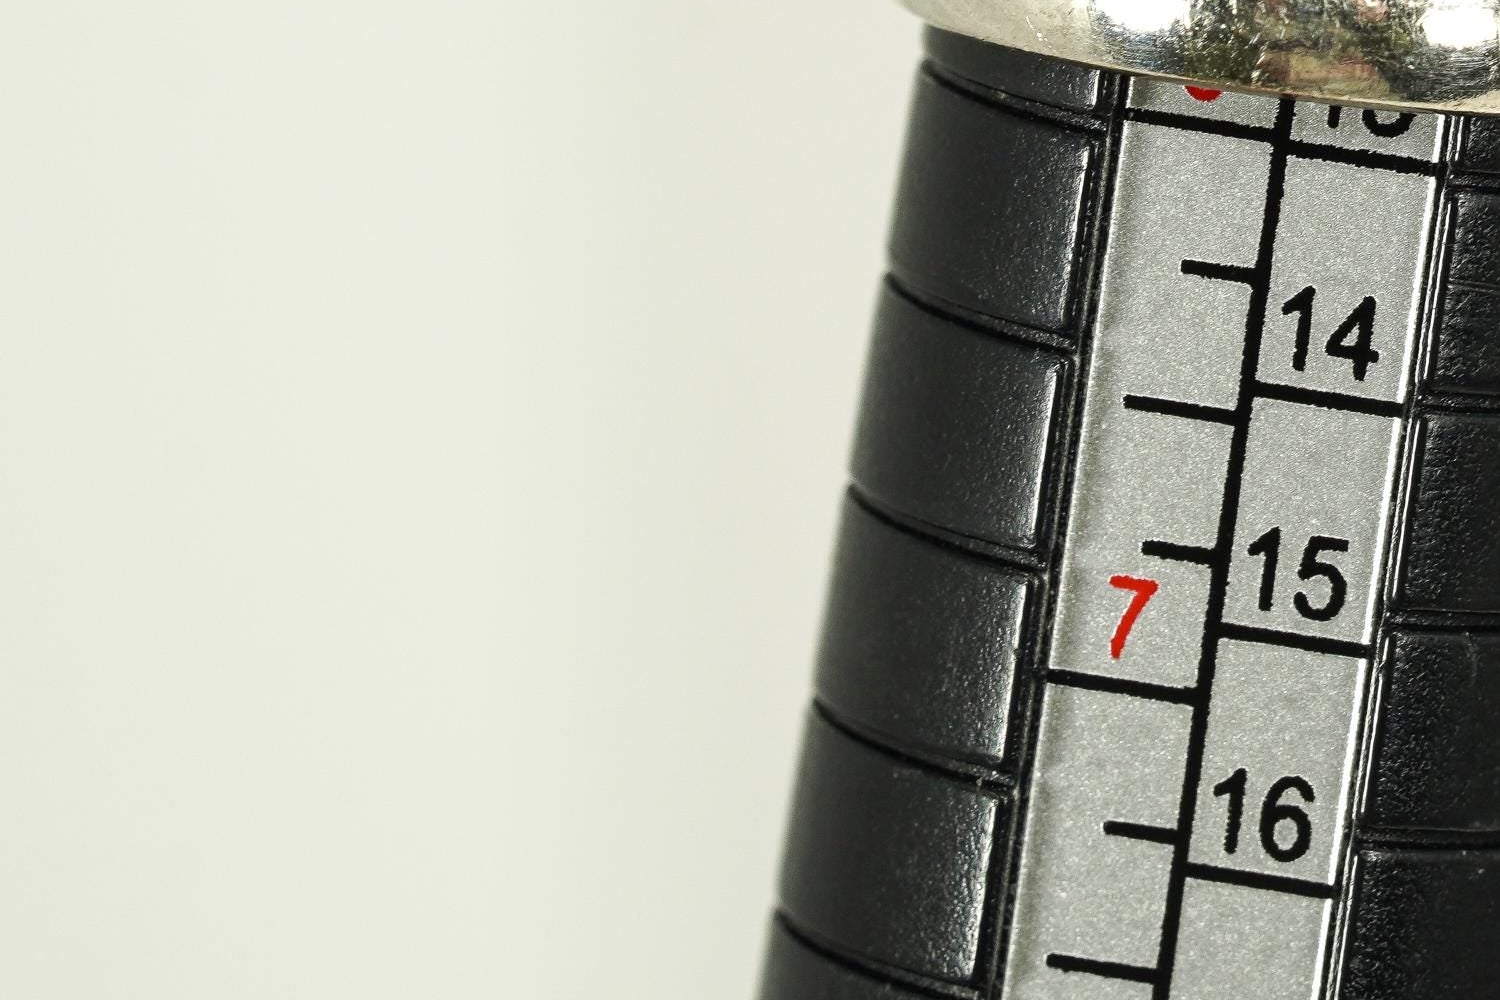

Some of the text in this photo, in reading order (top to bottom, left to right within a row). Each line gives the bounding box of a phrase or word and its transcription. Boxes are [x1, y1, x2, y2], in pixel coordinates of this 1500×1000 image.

[1282, 286, 1379, 381] 14
[1109, 574, 1159, 659] 7
[1248, 526, 1349, 622] 15
[1214, 768, 1315, 862] 16
